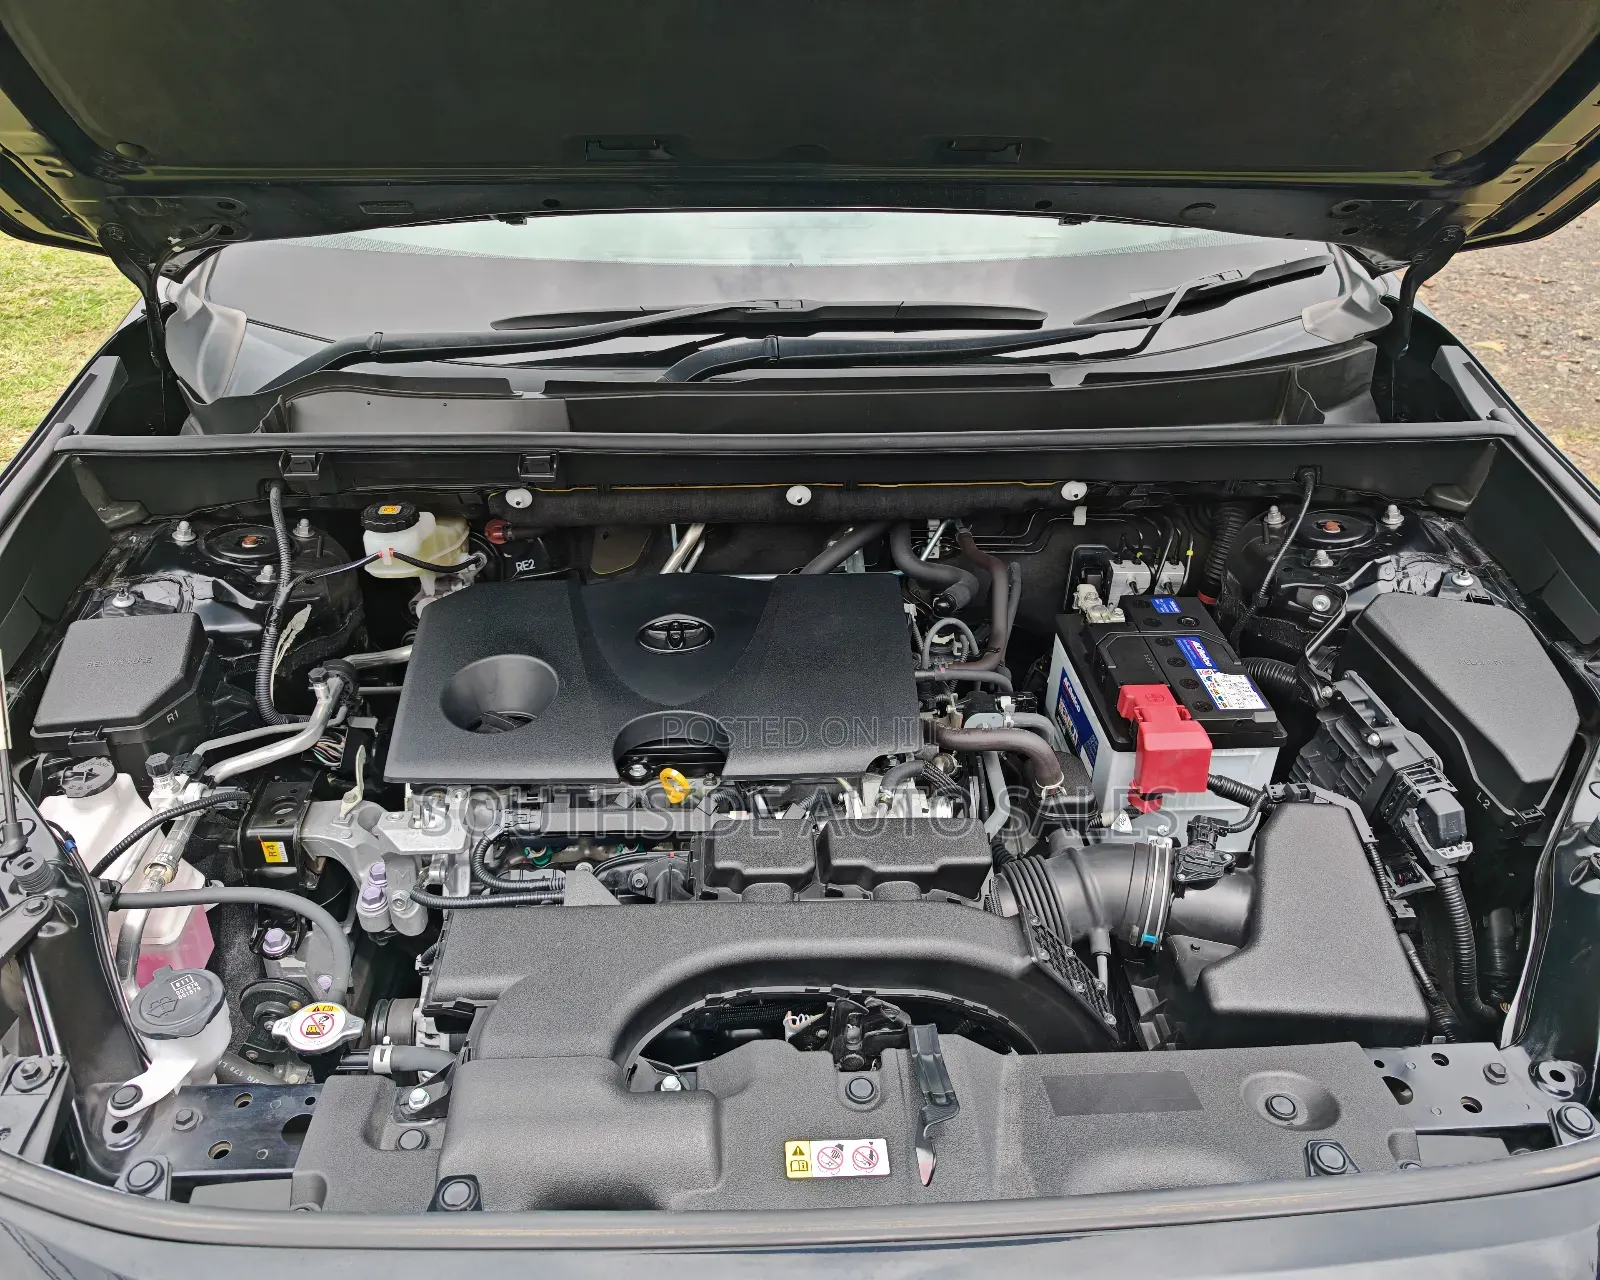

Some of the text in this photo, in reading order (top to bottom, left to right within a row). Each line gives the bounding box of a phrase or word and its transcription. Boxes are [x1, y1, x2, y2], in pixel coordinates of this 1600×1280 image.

[516, 559, 535, 571] RE2
[166, 709, 179, 724] R1
[1476, 791, 1490, 810] L2
